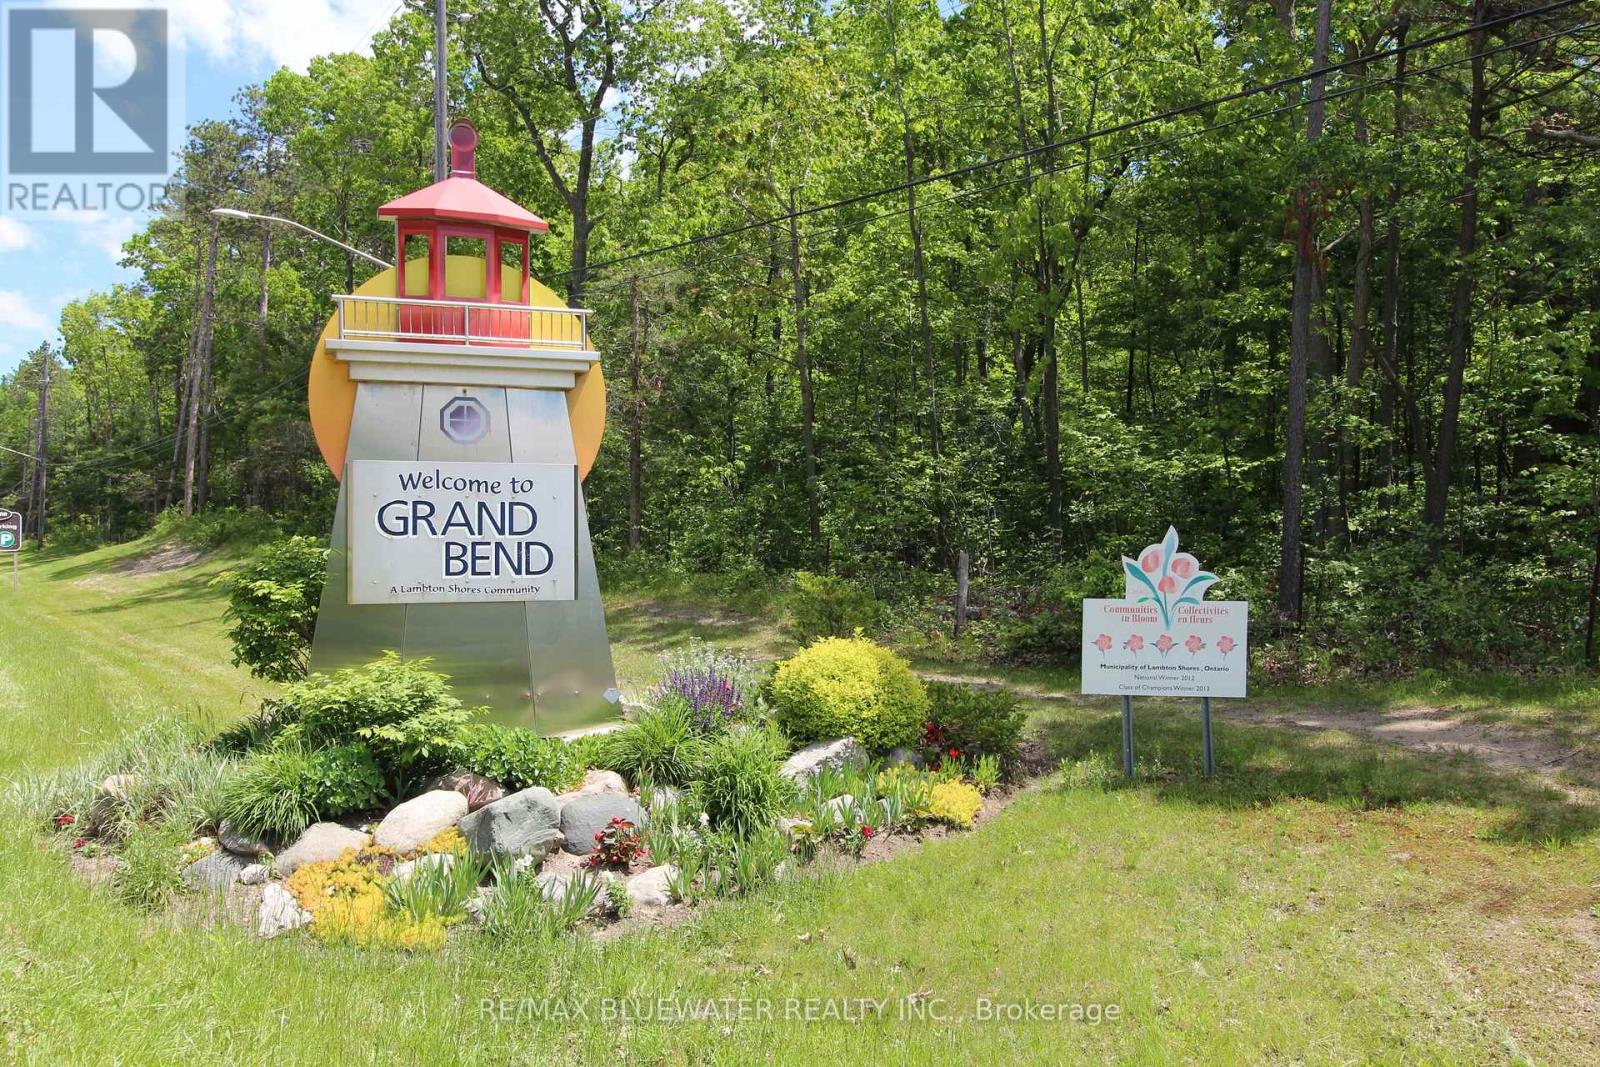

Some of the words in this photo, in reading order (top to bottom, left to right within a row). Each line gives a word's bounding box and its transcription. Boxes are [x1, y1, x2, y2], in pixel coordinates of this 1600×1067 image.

[399, 469, 501, 494] Welcome
[510, 477, 534, 494] to
[376, 499, 538, 537] GRAND
[443, 541, 555, 577] BEND
[390, 586, 398, 594] A
[401, 583, 445, 593] Lambton
[448, 584, 481, 594] Shores
[484, 585, 541, 595] Community
[1103, 605, 1158, 614] Communities
[1121, 614, 1130, 622] in
[1132, 614, 1158, 623] Bloom
[1177, 616, 1187, 624] en
[1189, 615, 1213, 624] fleurs
[1100, 663, 1138, 672] Municipality
[1141, 684, 1173, 692] Champions
